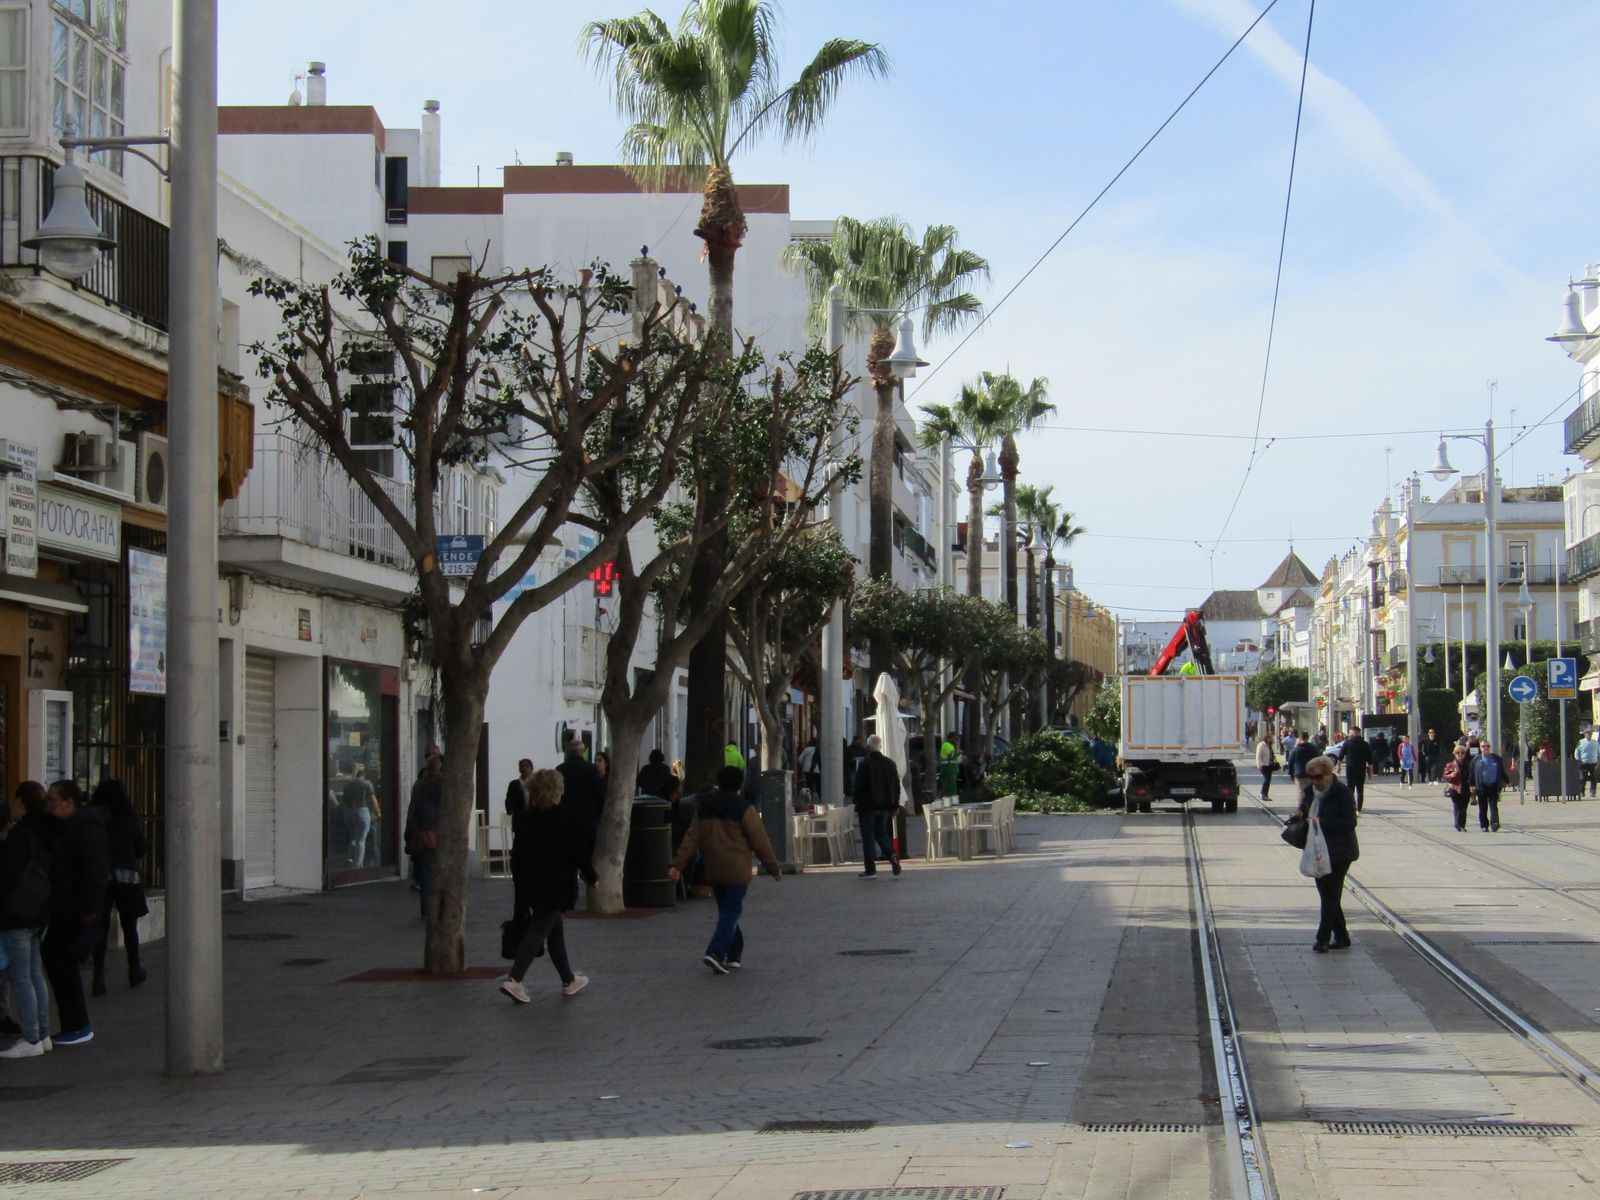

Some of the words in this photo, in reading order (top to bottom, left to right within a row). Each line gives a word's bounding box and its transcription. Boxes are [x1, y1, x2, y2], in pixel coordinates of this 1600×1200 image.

[13, 514, 32, 529] DIGITAL
[41, 499, 116, 546] FOTOGRAFIA
[439, 552, 473, 561] ENDE
[447, 564, 463, 574] 215
[1551, 661, 1567, 683] P
